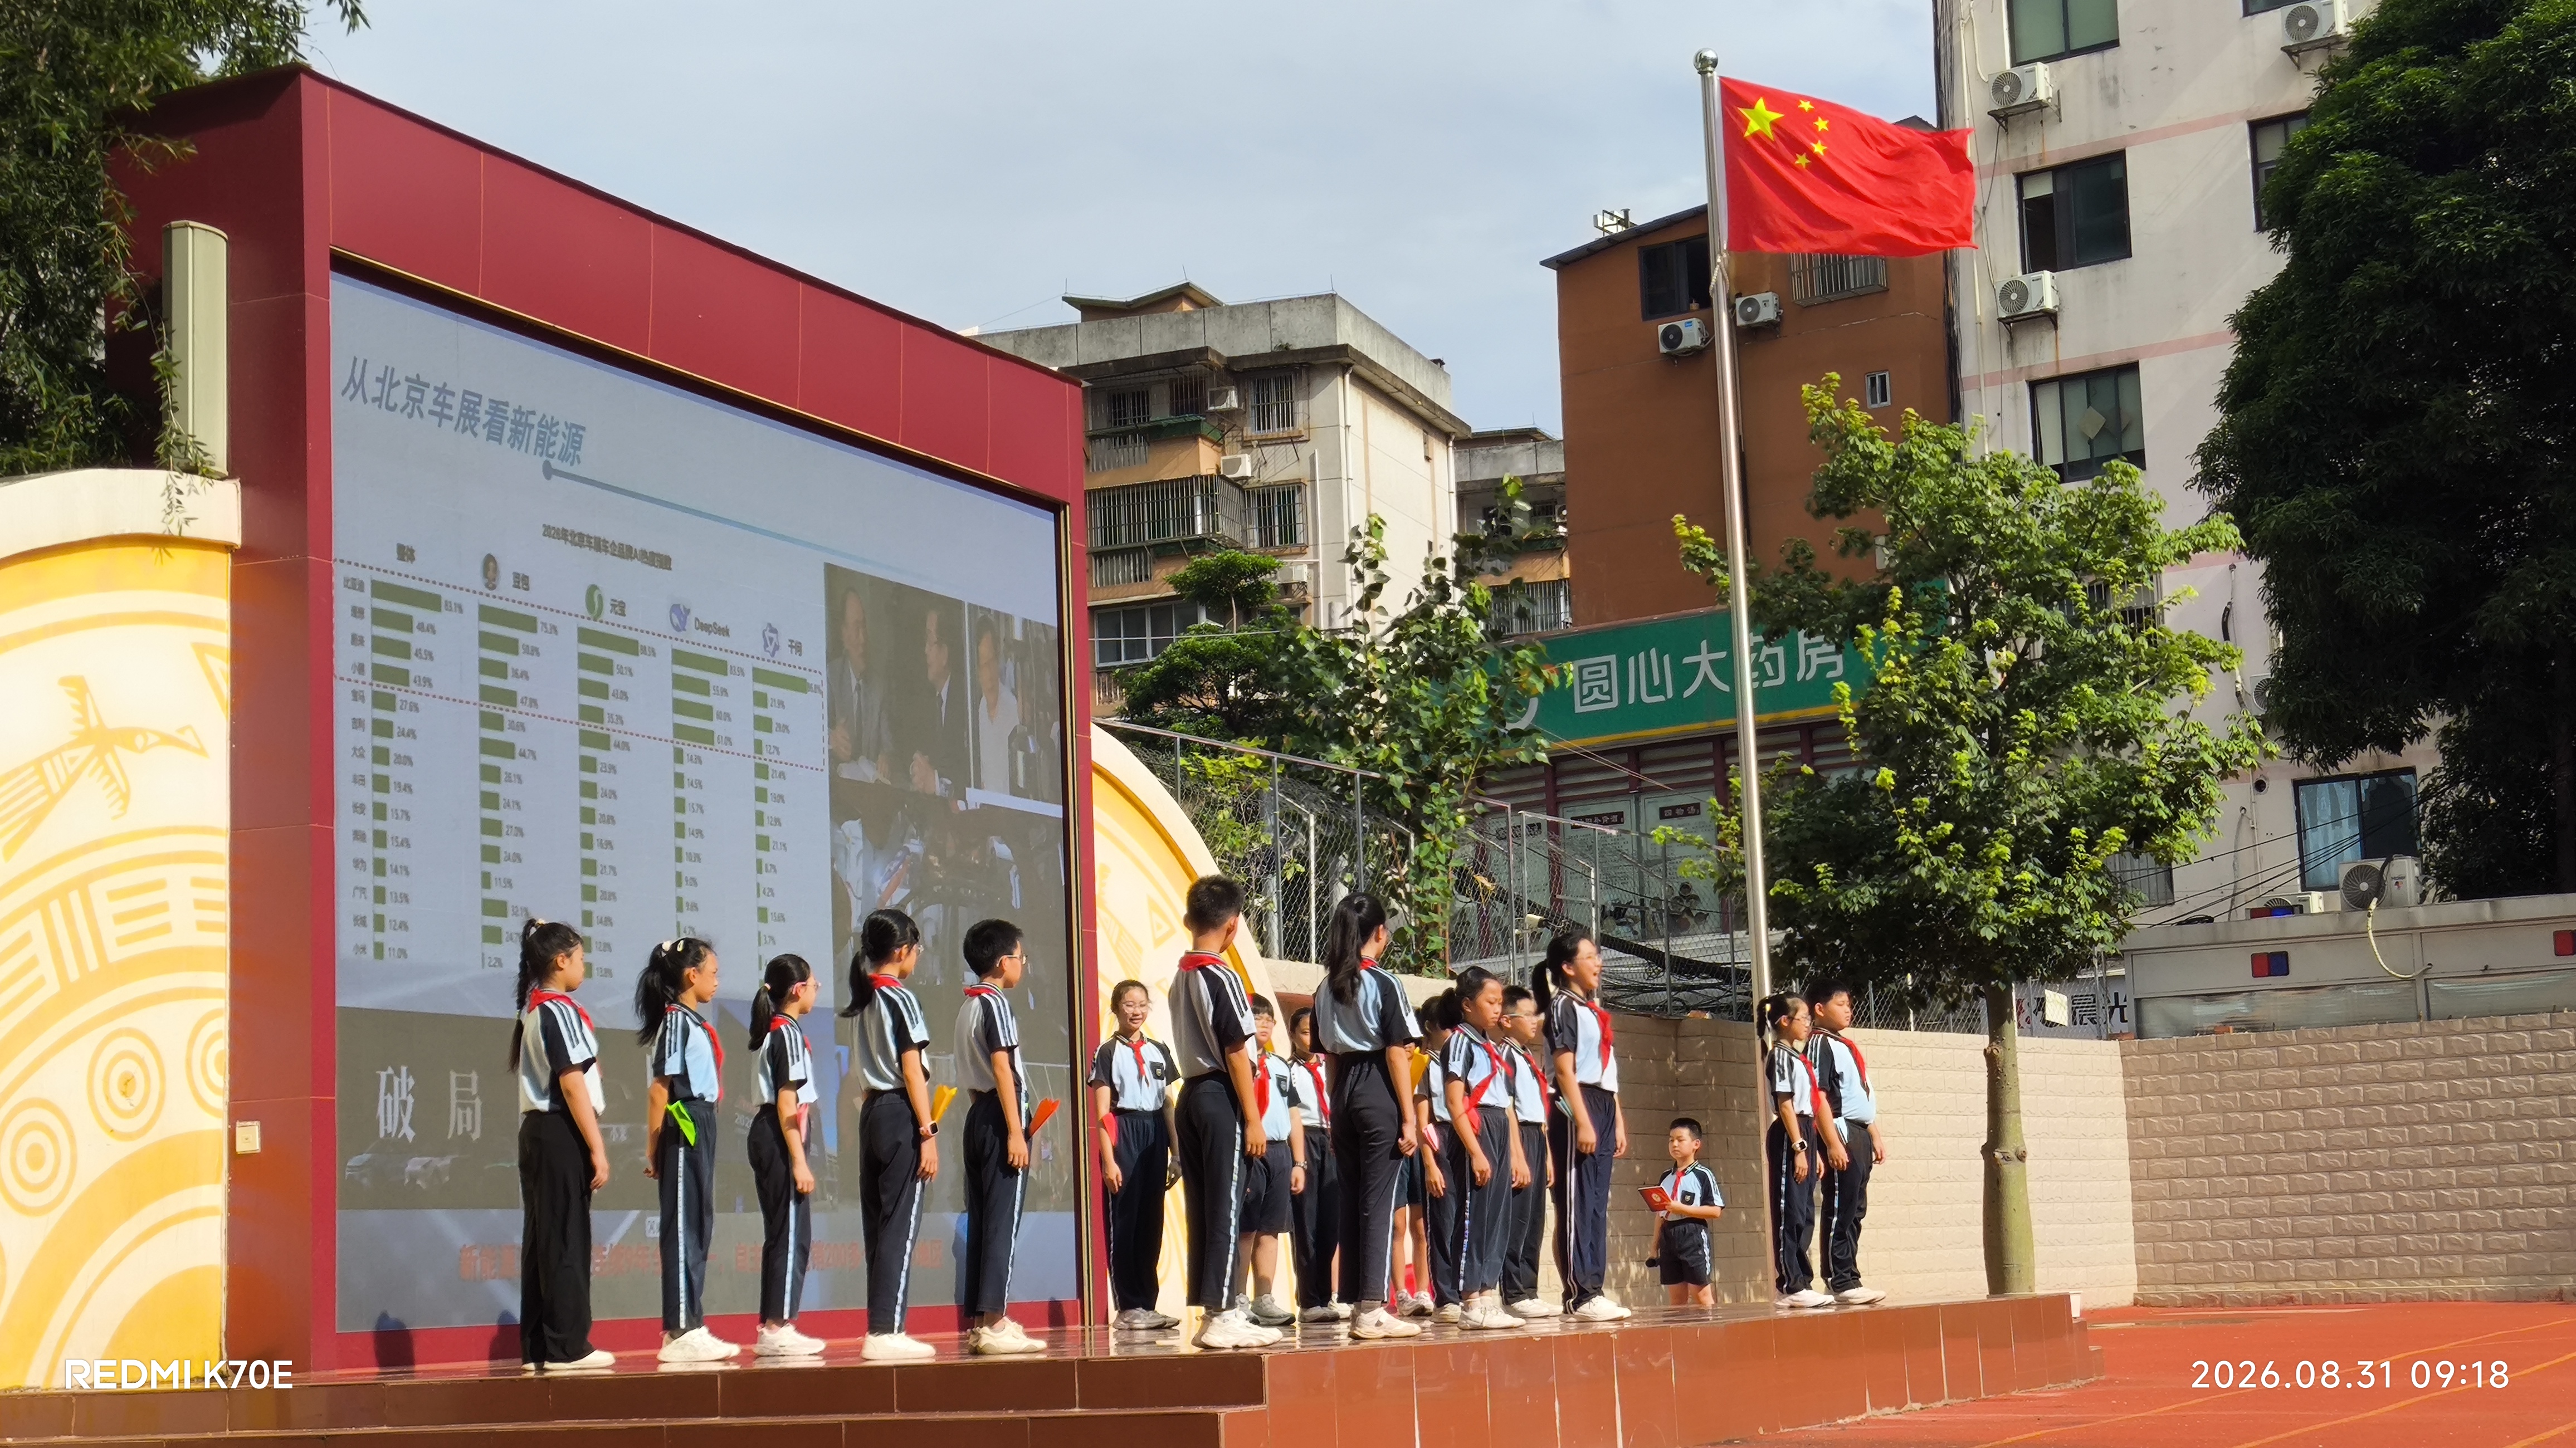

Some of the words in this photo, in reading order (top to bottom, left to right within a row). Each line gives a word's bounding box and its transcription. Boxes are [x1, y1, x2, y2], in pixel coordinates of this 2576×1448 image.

[341, 356, 586, 467] 从北京车展看新能源
[695, 618, 730, 638] DeepSeek
[1574, 632, 1843, 713] 圆心大药房
[376, 1065, 482, 1142] 破局
